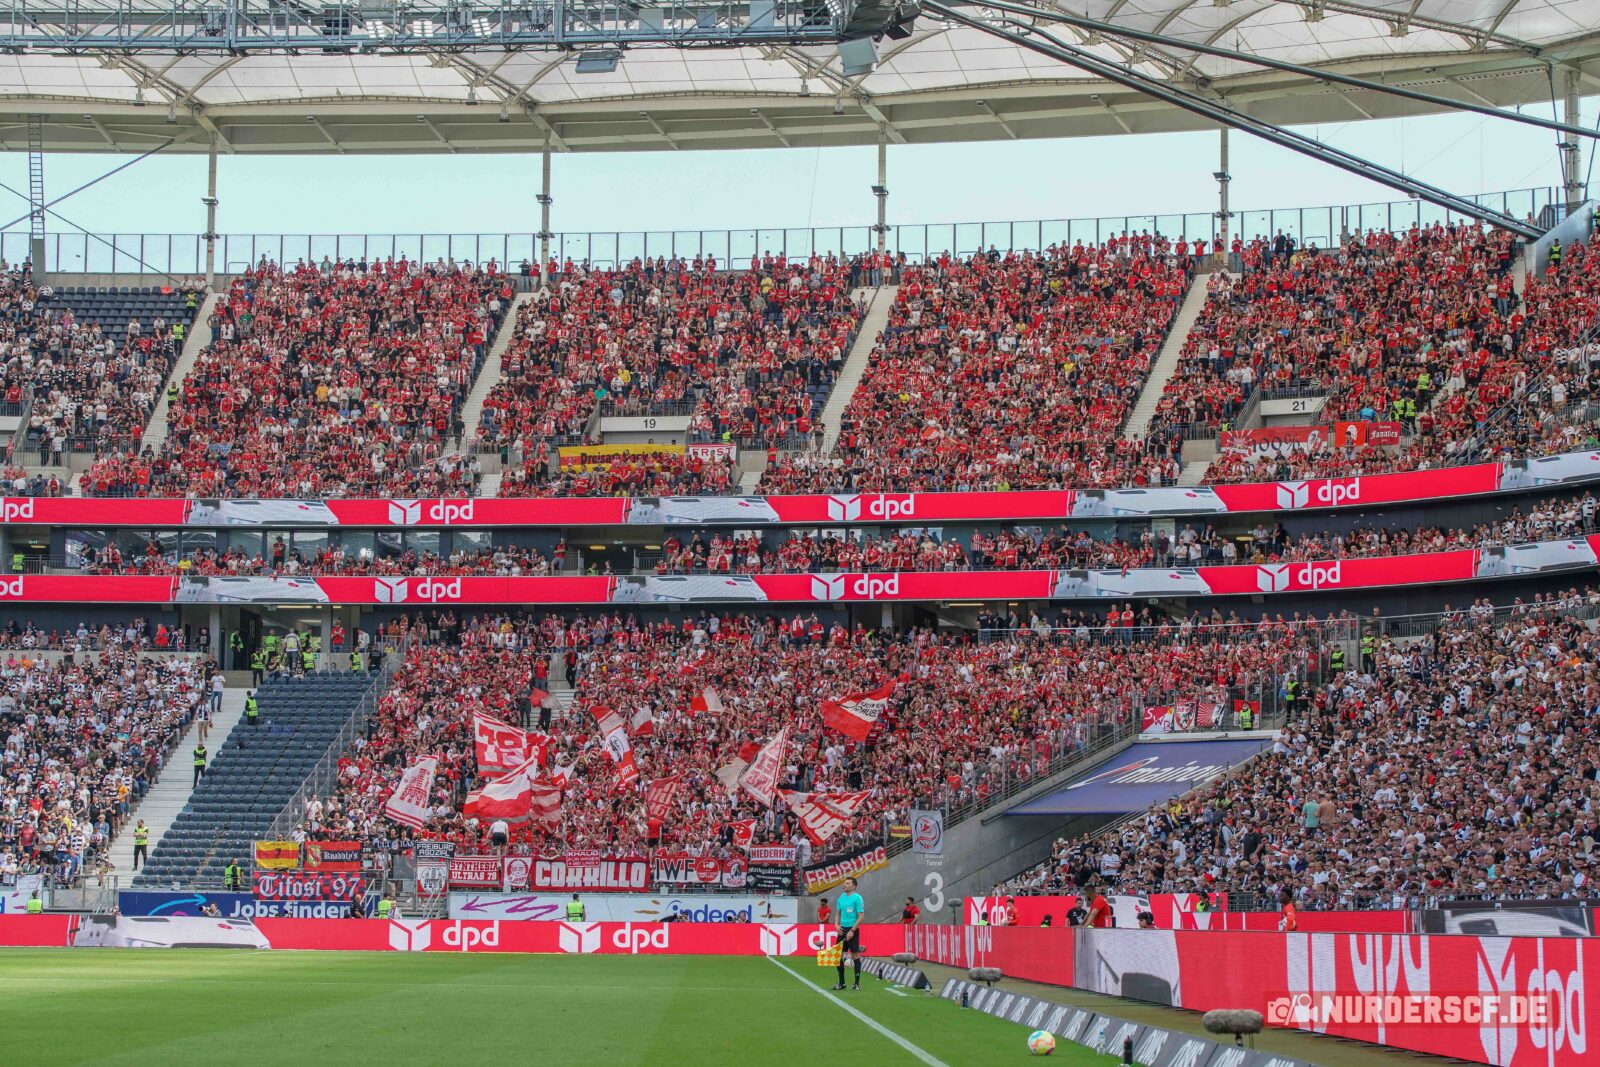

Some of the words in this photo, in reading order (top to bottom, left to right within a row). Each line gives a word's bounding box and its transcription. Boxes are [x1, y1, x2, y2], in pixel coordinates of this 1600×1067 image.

[1292, 401, 1305, 412] 21
[643, 419, 656, 429] 19
[692, 447, 733, 457] FRST
[1250, 433, 1303, 453] 100%
[1317, 477, 1360, 507] dpd
[430, 499, 474, 524] dpd
[869, 493, 915, 520] dpd
[853, 573, 899, 600] dpd
[1297, 560, 1341, 590] dpd
[416, 577, 461, 603] dpd
[416, 843, 454, 851] FREIBURG
[450, 860, 499, 870] SYNTHESIA
[452, 871, 486, 880] ULTRAS
[805, 846, 887, 888] FREIBURG
[258, 875, 324, 898] Tifosi
[332, 877, 361, 898] 97
[924, 871, 945, 913] 3
[230, 900, 279, 918] Jobs
[442, 920, 500, 952] dpd
[612, 921, 670, 954] dpd
